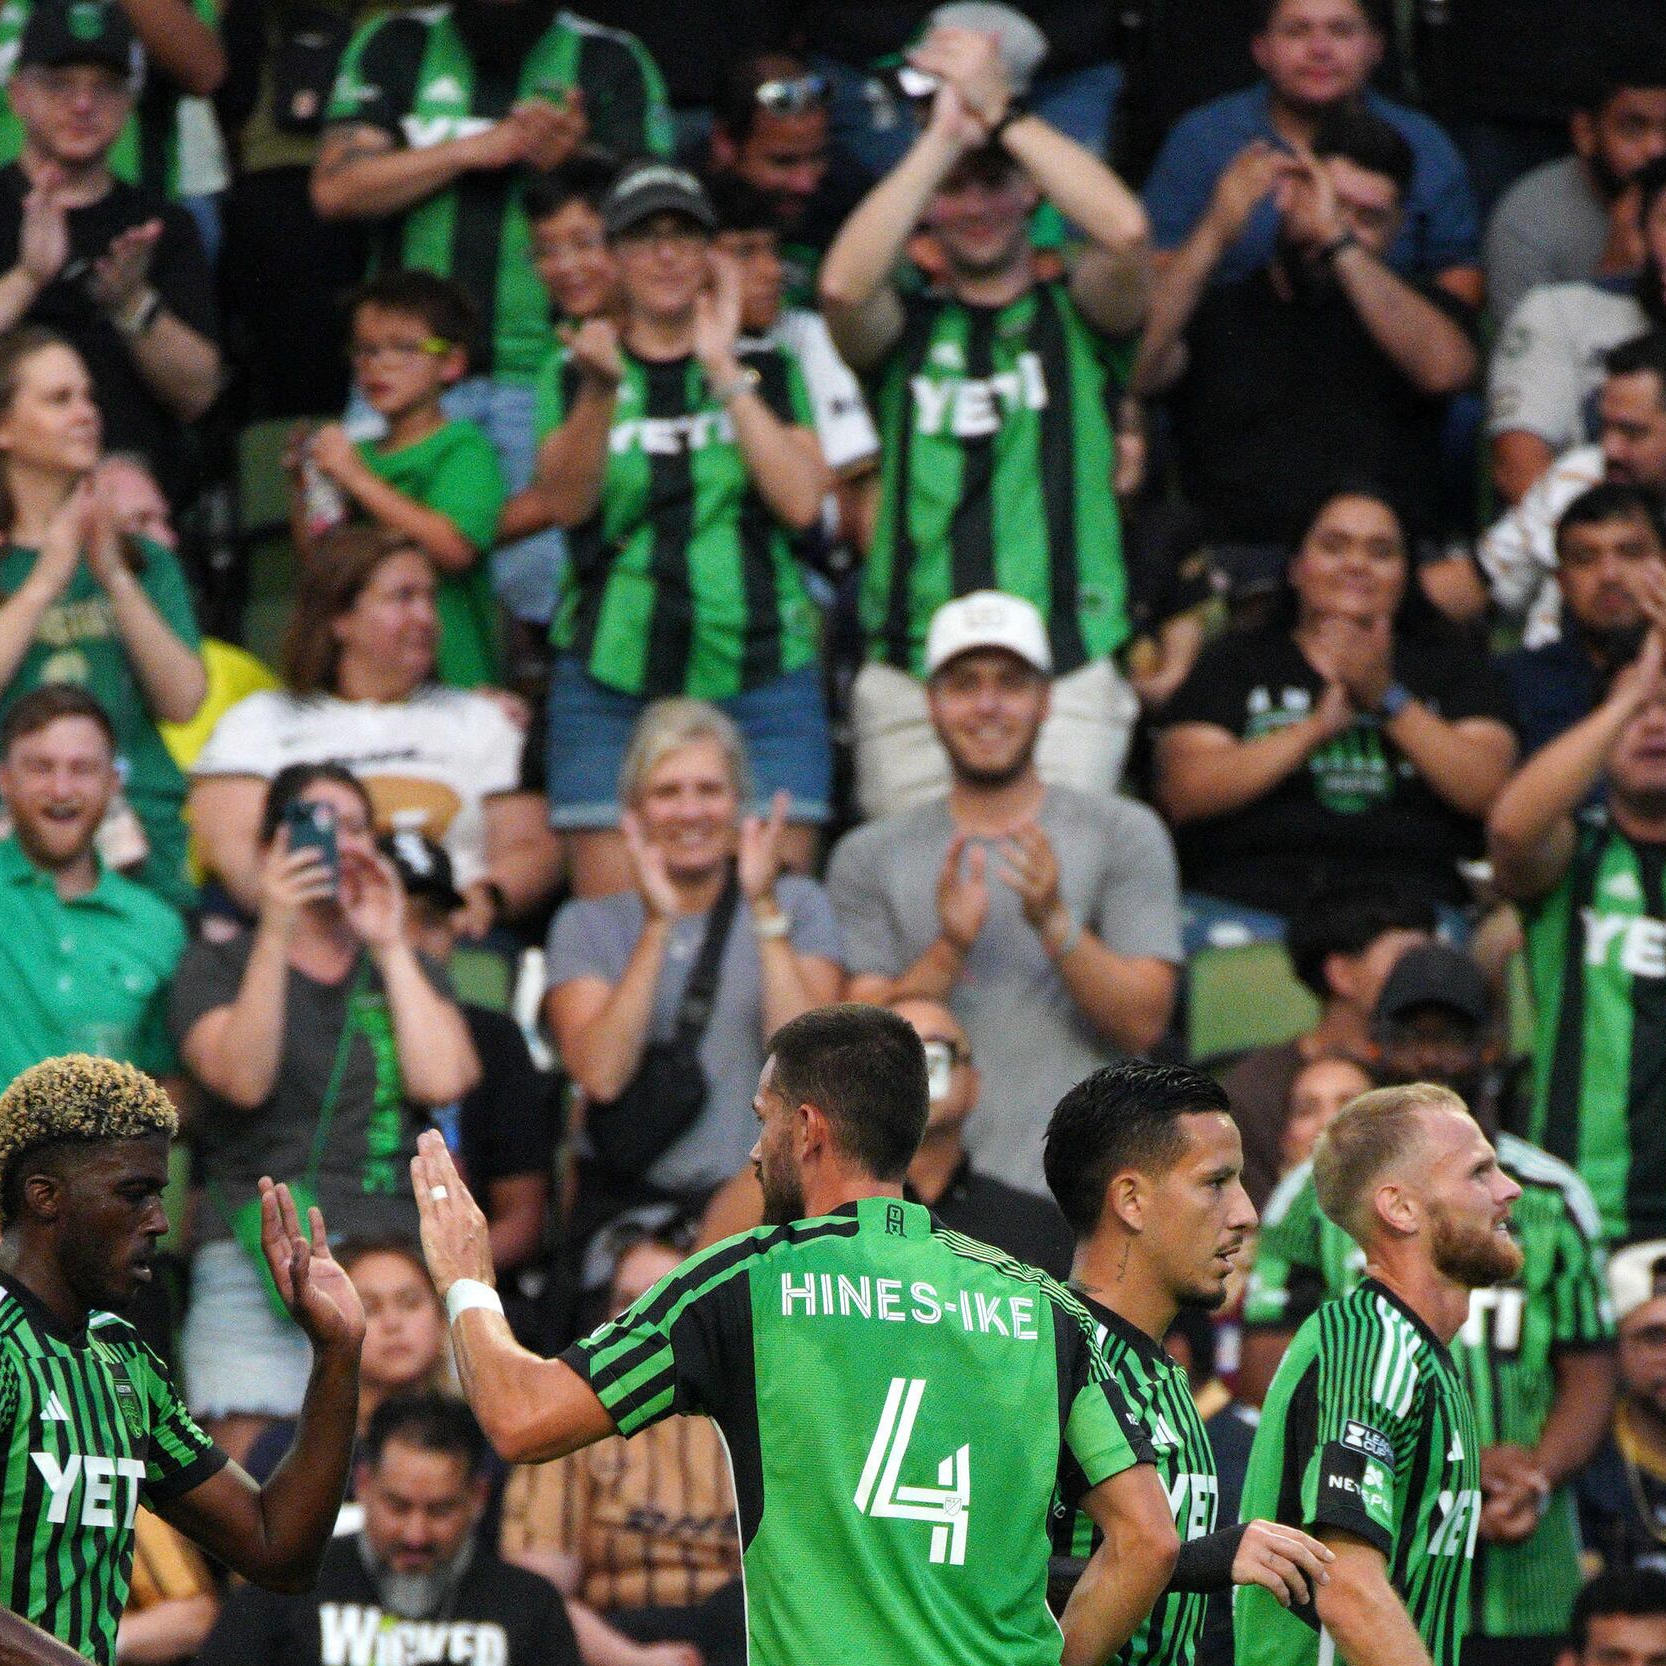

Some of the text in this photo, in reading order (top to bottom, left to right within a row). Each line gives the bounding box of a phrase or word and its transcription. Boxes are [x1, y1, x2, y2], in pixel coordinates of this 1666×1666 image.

[910, 353, 1047, 437] YETI
[781, 1272, 1039, 1341] HINES-IKE
[30, 1452, 146, 1528] YET
[853, 1377, 971, 1567] 4
[1427, 1489, 1483, 1559] YET
